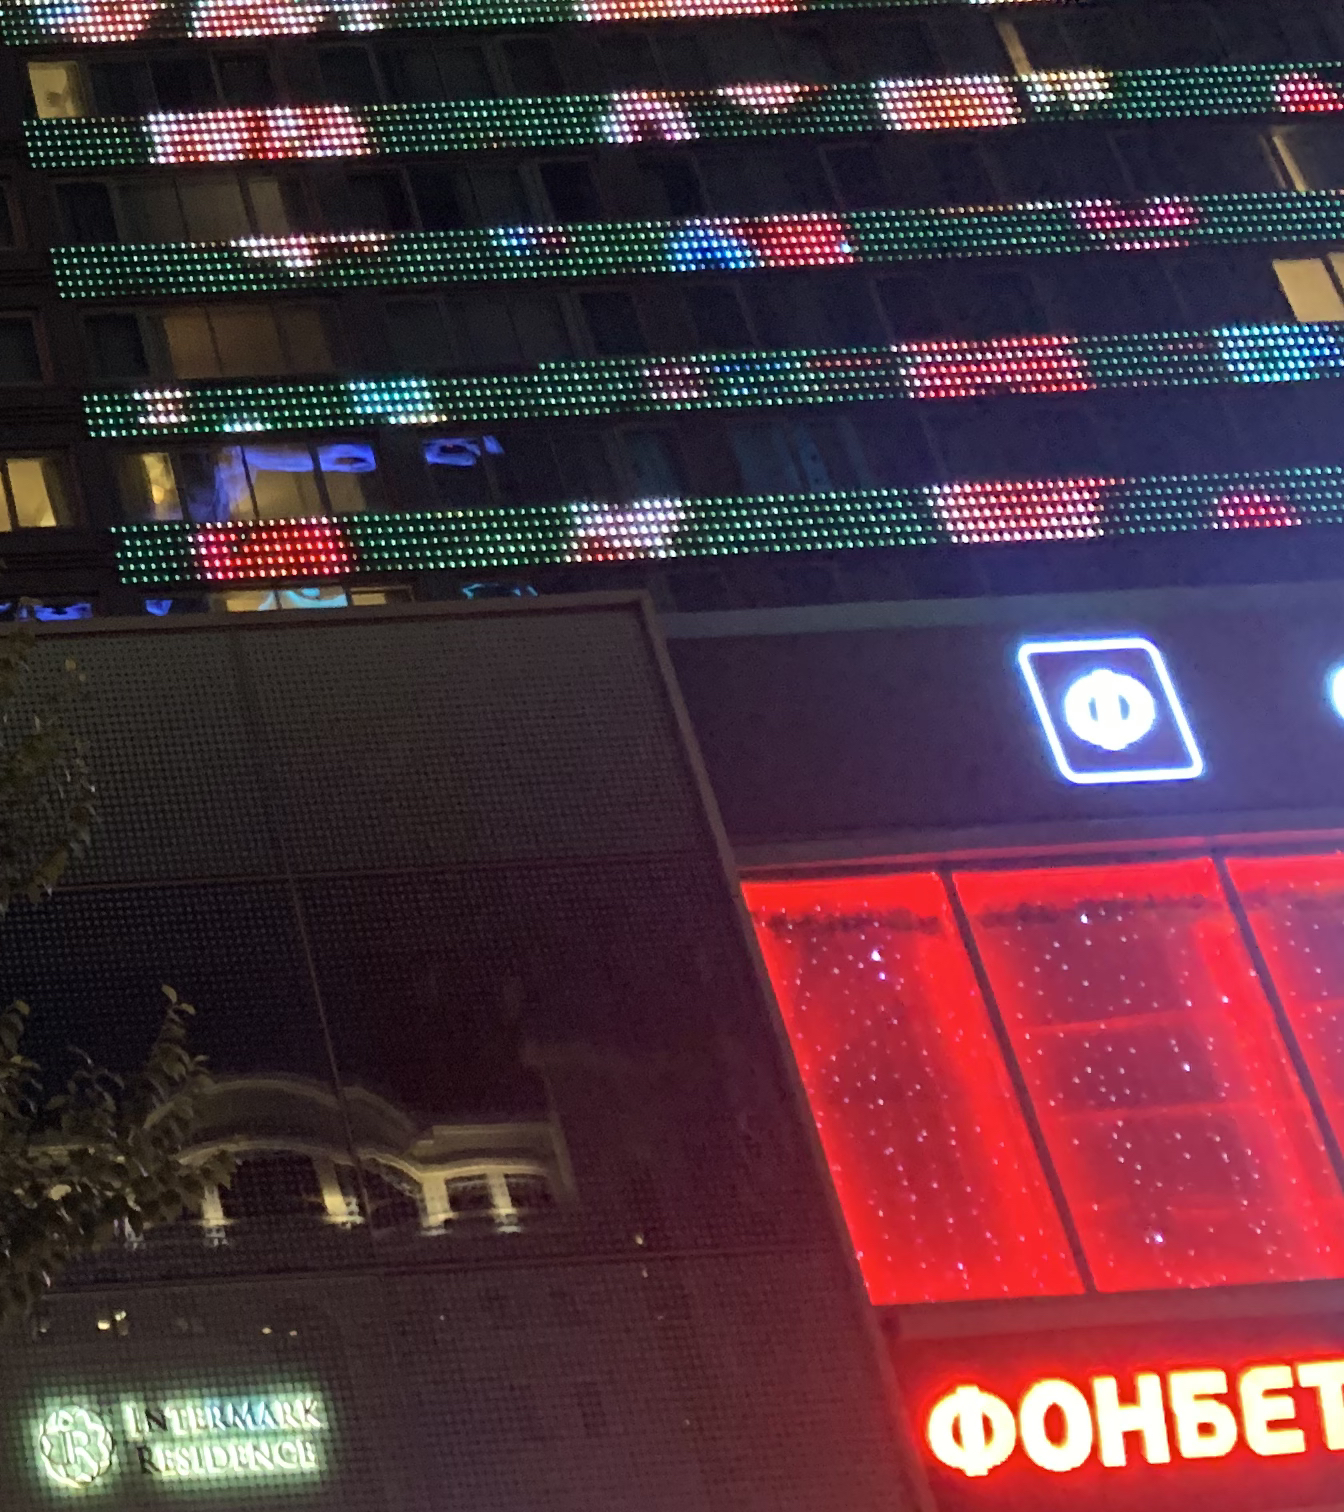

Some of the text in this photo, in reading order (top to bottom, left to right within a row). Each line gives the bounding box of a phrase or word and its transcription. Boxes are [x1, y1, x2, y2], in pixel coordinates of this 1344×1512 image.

[122, 1397, 322, 1438] INTERMARK
[927, 1360, 1344, 1477] ФОНБЕТ
[136, 1439, 318, 1476] RESIDENCE
